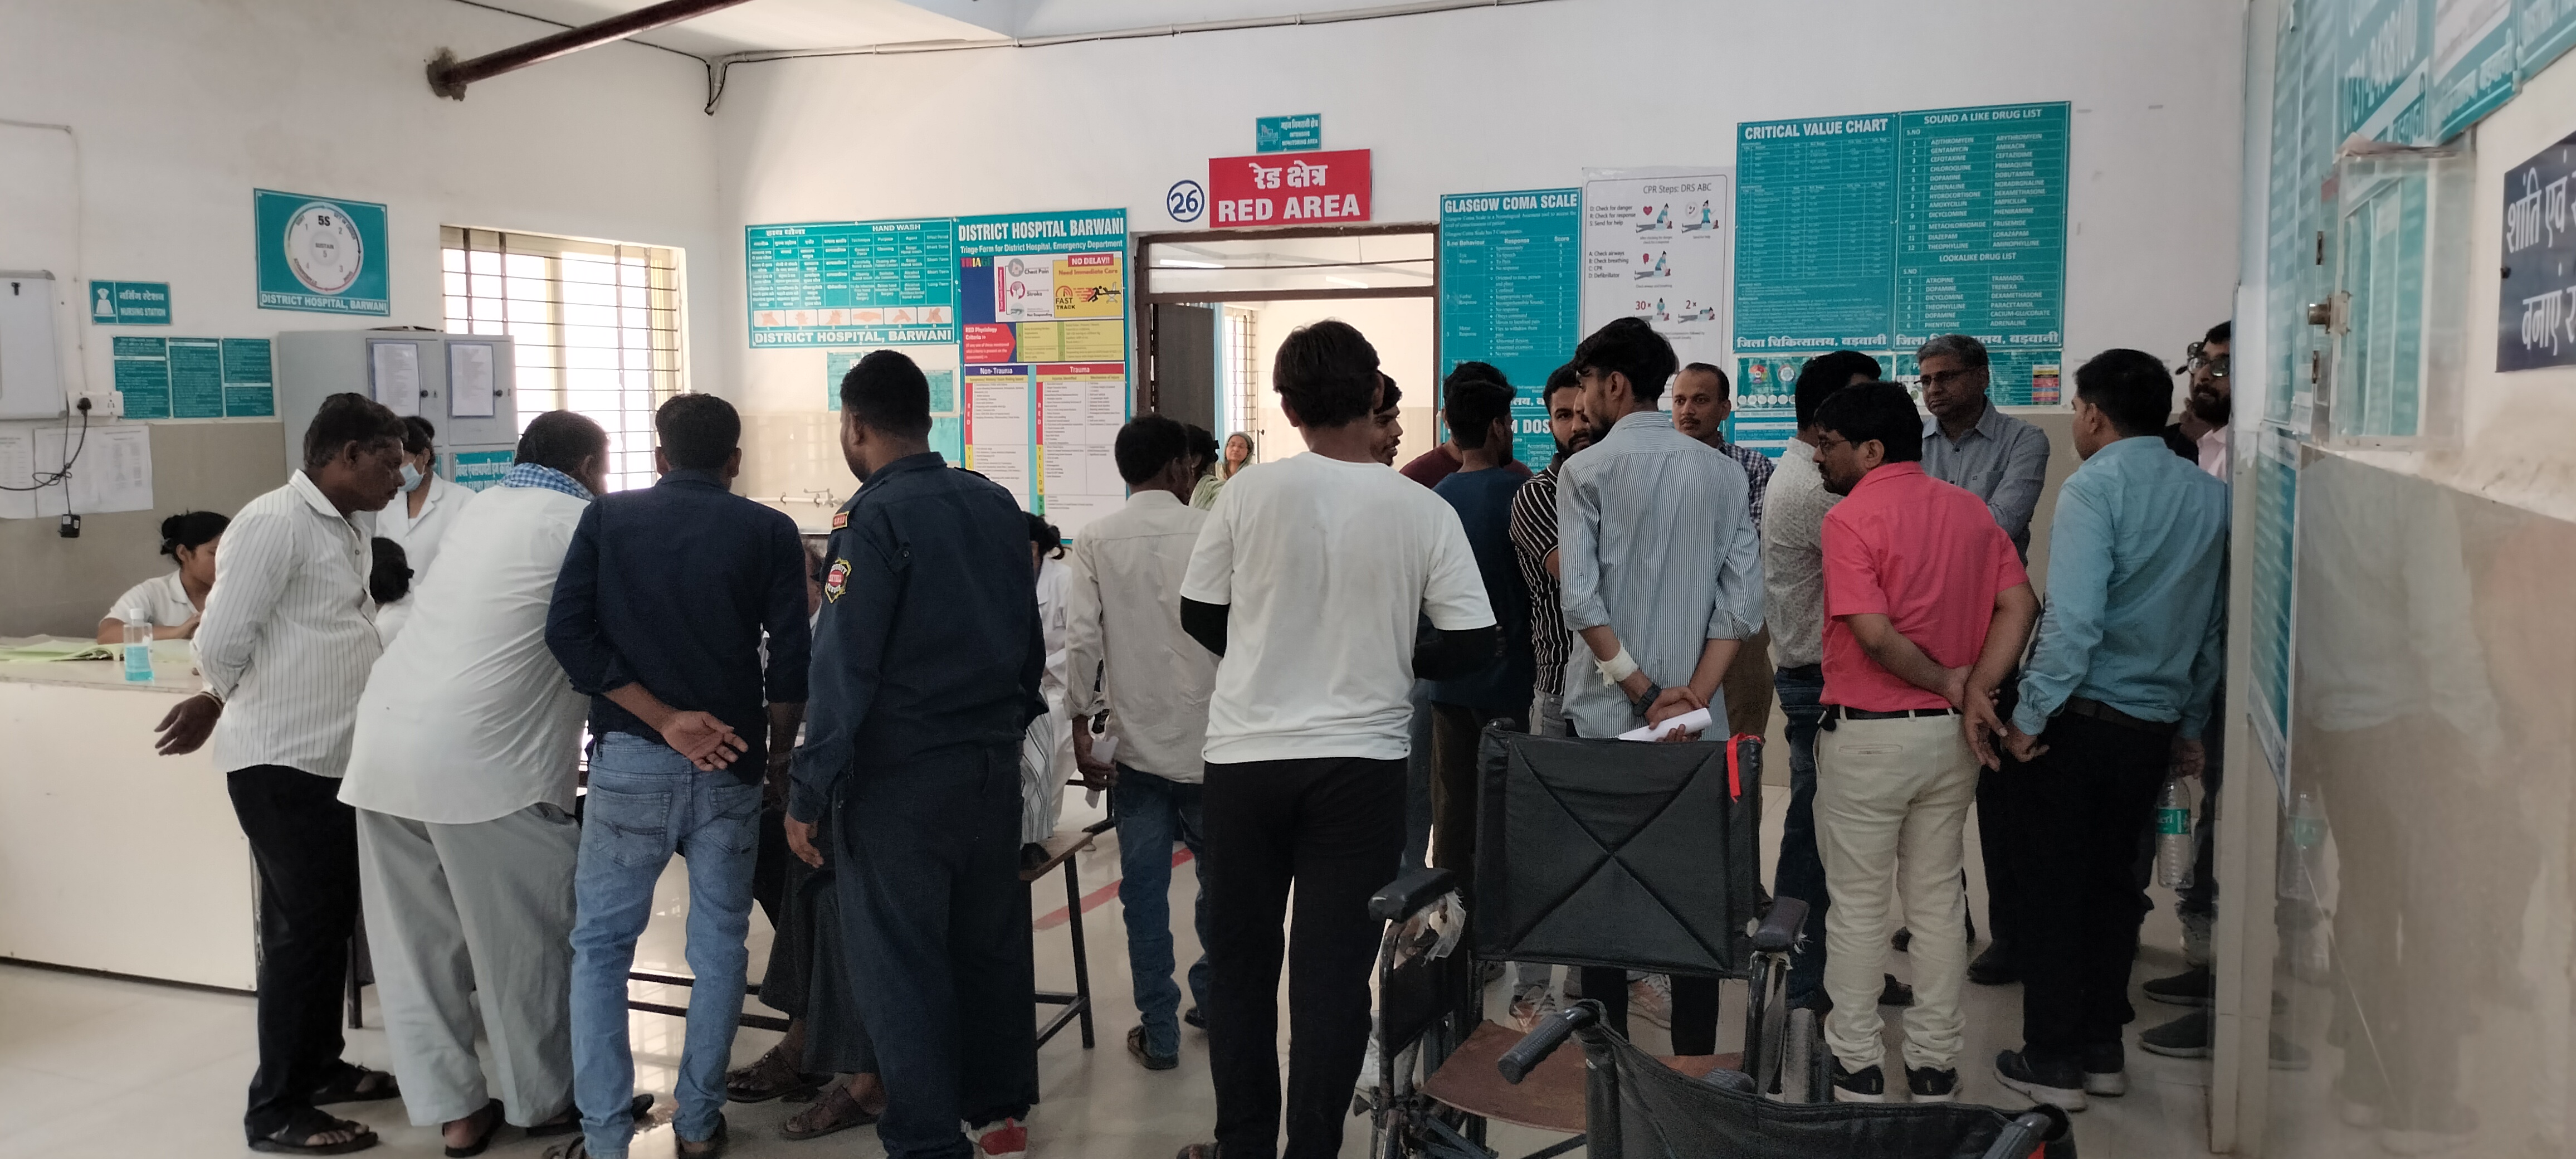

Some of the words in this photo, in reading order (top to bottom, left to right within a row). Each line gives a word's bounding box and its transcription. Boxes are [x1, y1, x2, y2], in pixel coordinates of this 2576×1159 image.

[1924, 114, 1958, 124] SOUND
[1960, 113, 1968, 121] A
[1970, 112, 1989, 121] LIKE
[1992, 110, 2020, 120] DRUG
[2023, 109, 2042, 118] LIST
[1745, 124, 1799, 139] CRITICAL
[1803, 121, 1842, 136] VALUE
[1846, 119, 1888, 133] CHART
[1249, 162, 1282, 190] रेड
[1287, 160, 1328, 188] क्षेत्र
[1643, 186, 1657, 194] CPR
[1659, 185, 1679, 194] Steps:
[1681, 184, 1695, 192] DRS
[1697, 183, 1711, 191] ABC
[1171, 189, 1198, 214] 26
[1219, 198, 1273, 222] RED
[1283, 194, 1360, 220] AREA
[1445, 198, 1499, 213] GLASGOW
[1503, 196, 1537, 210] COMA
[1541, 194, 1577, 208] SCALE
[2507, 167, 2542, 254] शांति
[2545, 149, 2567, 248] एवं
[318, 215, 330, 226] 5S
[959, 223, 1009, 241] DISTRICT
[1012, 221, 1067, 239] HOSPITAL
[1070, 218, 1124, 236] BARWANI
[1026, 242, 1052, 251] Hospital,
[1053, 241, 1086, 250] Emergency
[1087, 240, 1123, 249] Department
[961, 257, 992, 267] TRIAGE
[119, 290, 141, 301] नर्सिंग
[261, 294, 303, 306] DISTRICT
[305, 297, 348, 310] HOSPITAL,
[350, 301, 388, 311] BARWANI
[1636, 301, 1646, 310] 30
[1686, 300, 1691, 309] 2
[121, 308, 144, 316] NURSING
[145, 308, 166, 316] STATION
[755, 333, 813, 344] DISTRICT
[817, 332, 885, 343] HOSPITAL,
[889, 330, 951, 341] BARWANI
[1736, 337, 1765, 348] जिला
[1768, 335, 1838, 347] चिकित्सालय,
